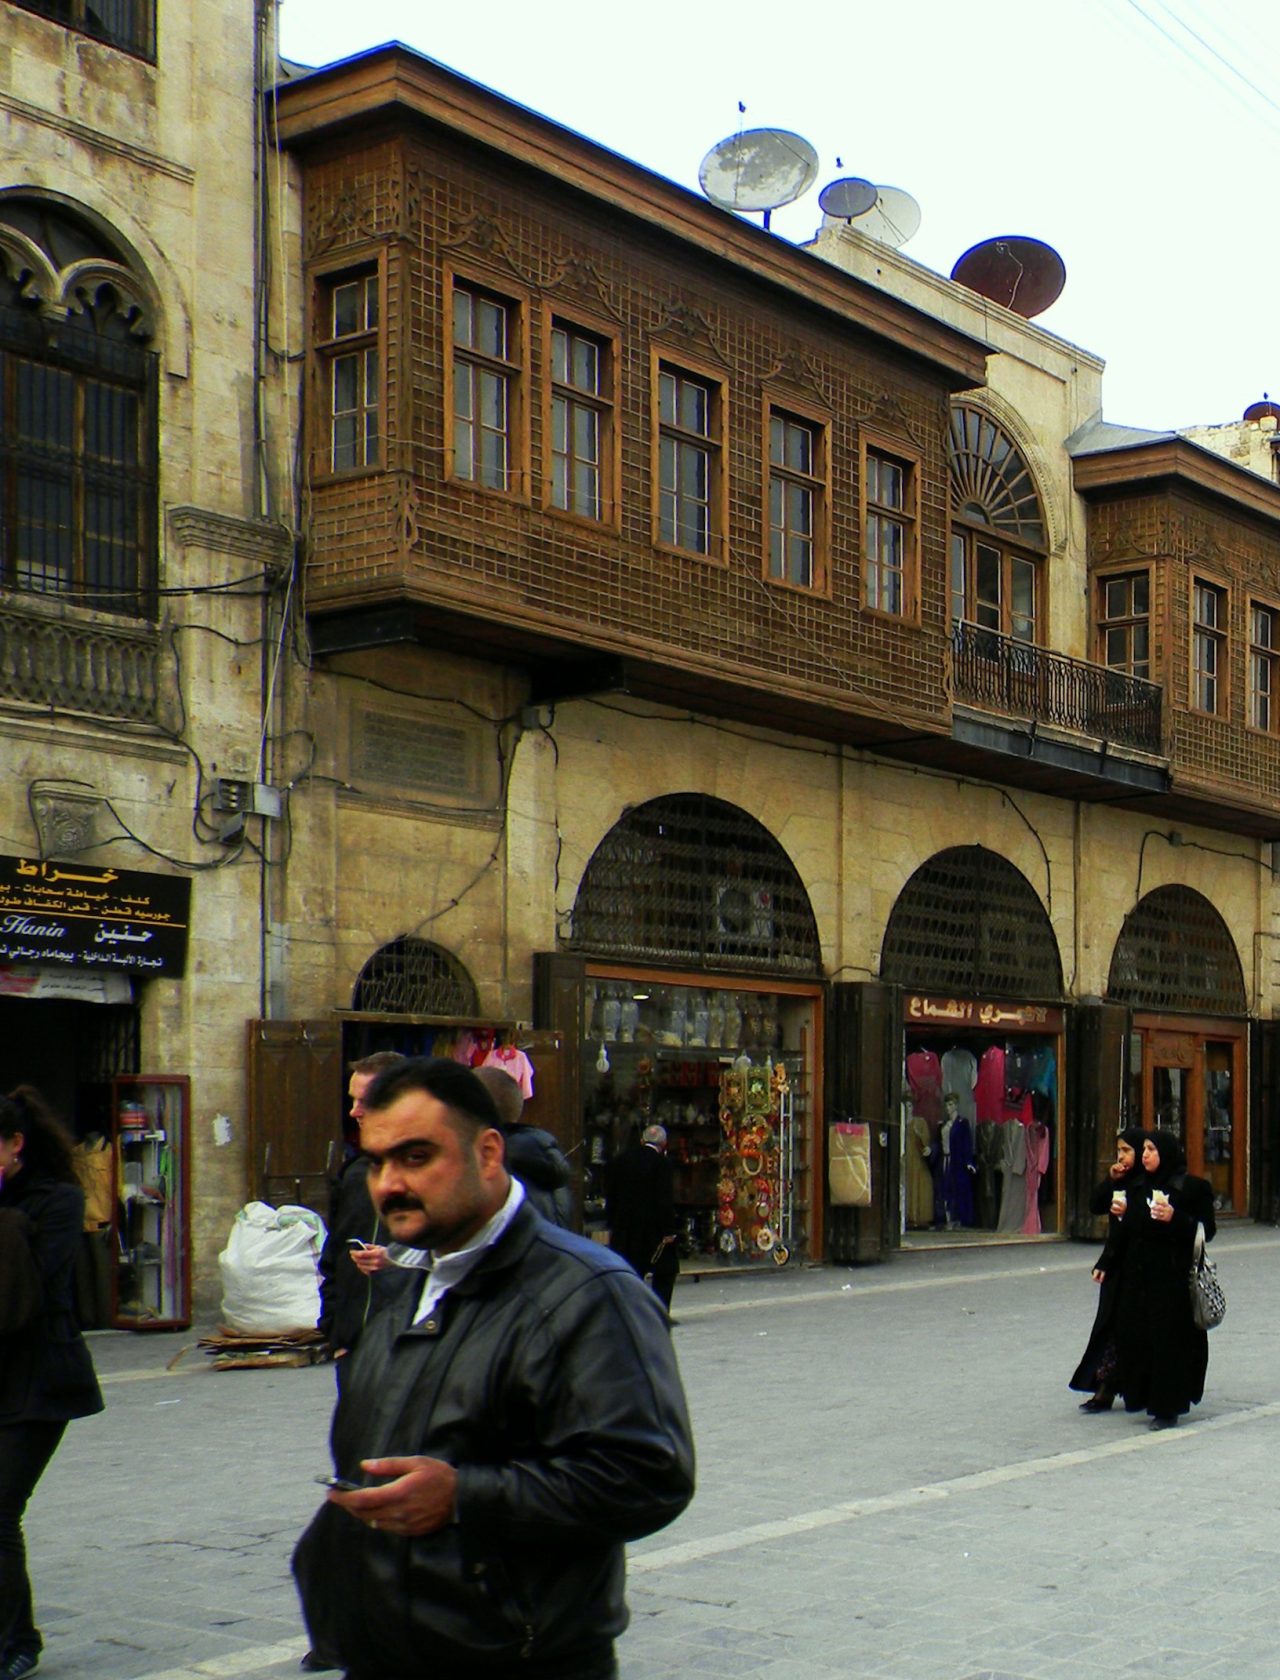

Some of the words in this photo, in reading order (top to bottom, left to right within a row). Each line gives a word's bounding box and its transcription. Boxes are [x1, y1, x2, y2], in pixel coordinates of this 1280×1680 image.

[16, 858, 120, 883] خراط
[0, 914, 66, 938] Hanin
[94, 922, 153, 944] حنين
